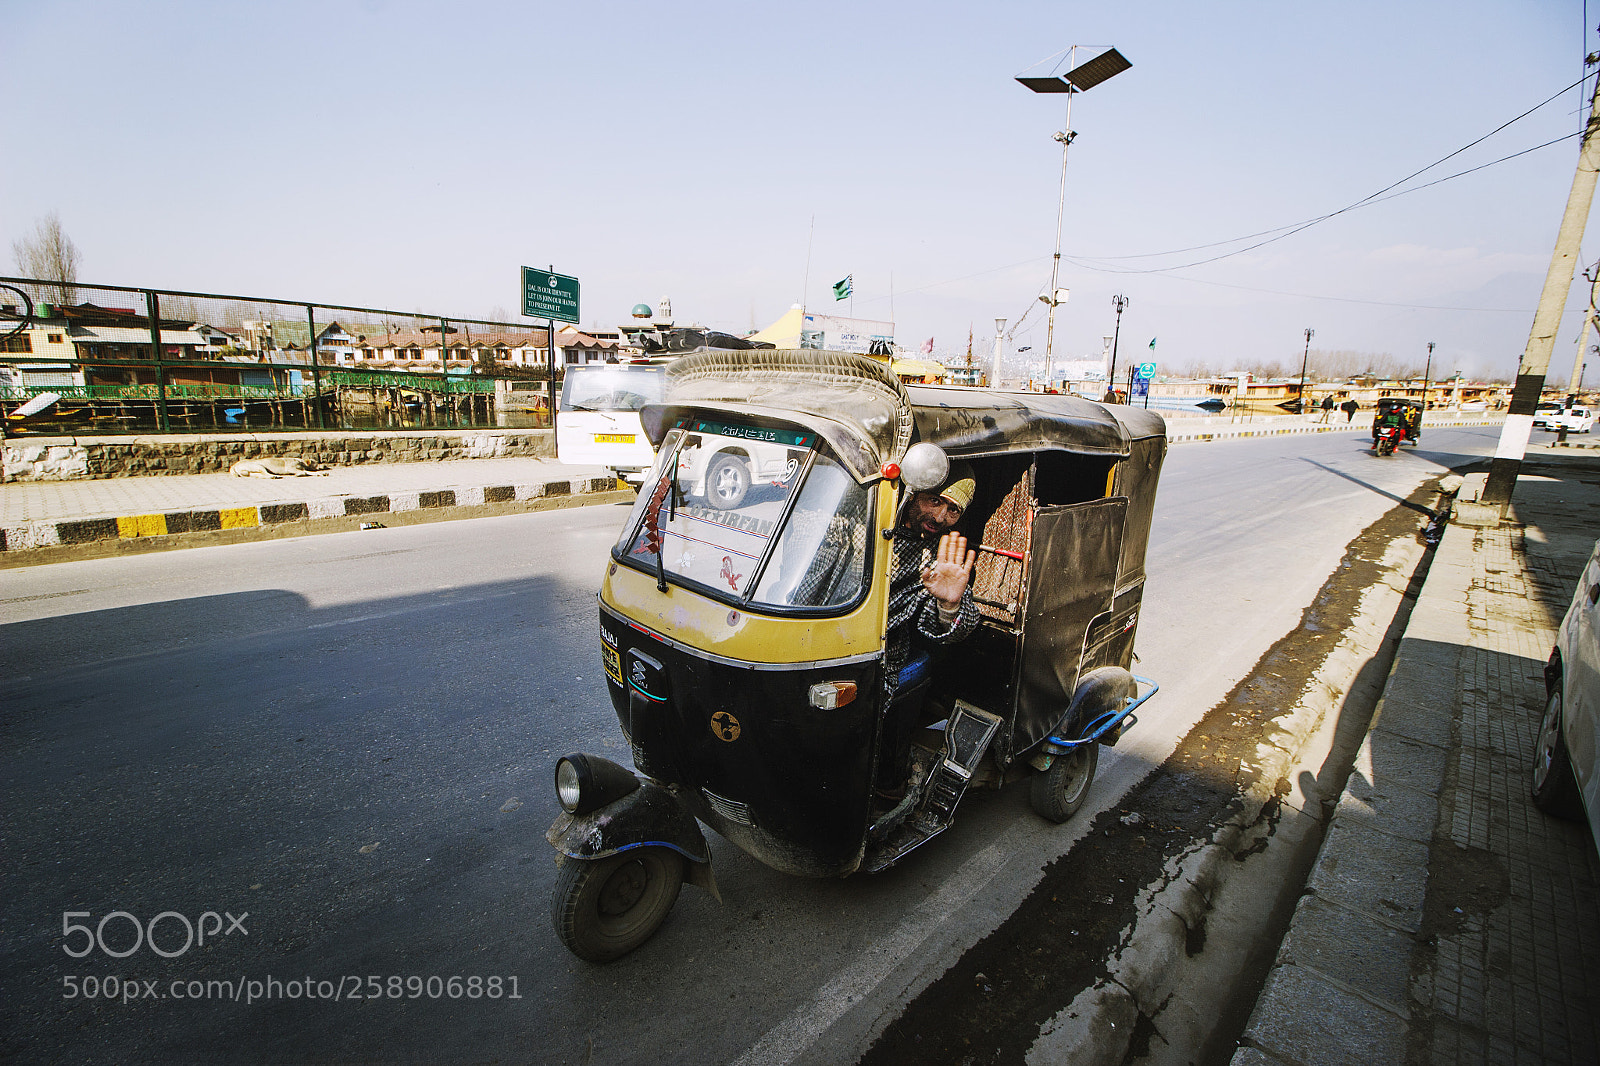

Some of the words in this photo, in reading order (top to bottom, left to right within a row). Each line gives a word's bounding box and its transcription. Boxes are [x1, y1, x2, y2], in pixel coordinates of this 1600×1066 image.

[541, 287, 551, 295] OUR
[534, 301, 555, 311] PRESERVE
[542, 294, 552, 303] JOIN
[561, 298, 577, 307] HANDS
[720, 511, 774, 535] IRFAN
